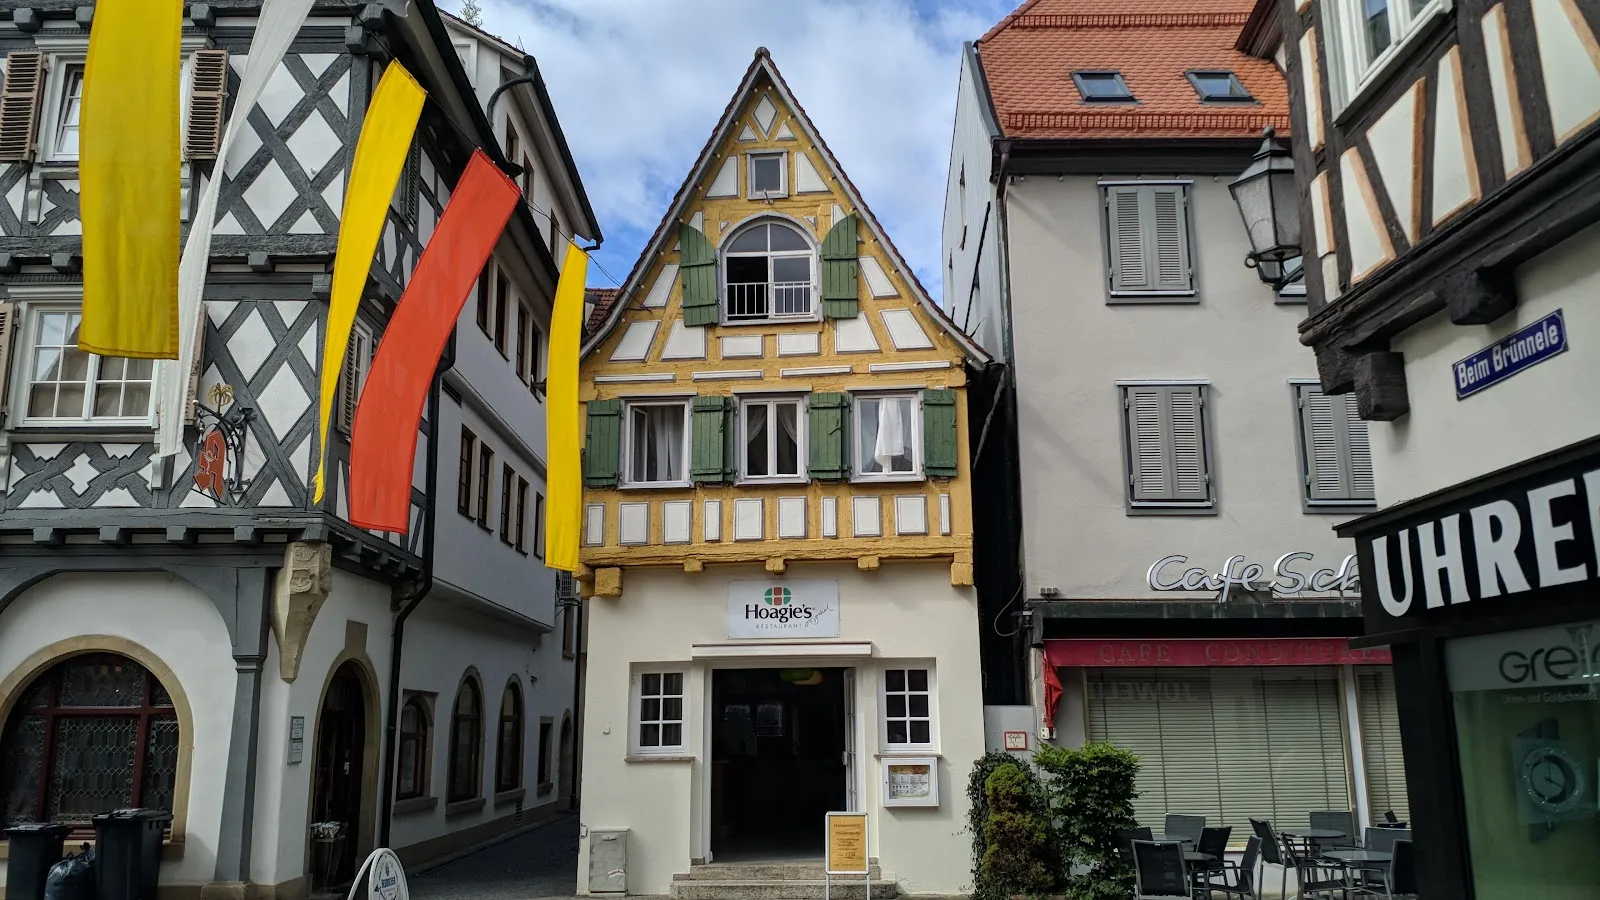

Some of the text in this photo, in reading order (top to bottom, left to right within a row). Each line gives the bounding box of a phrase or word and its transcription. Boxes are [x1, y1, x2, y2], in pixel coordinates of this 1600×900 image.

[1457, 320, 1560, 389] Beim Brünnele
[1146, 554, 1264, 603] Cafe
[745, 604, 812, 623] Hoagie's
[1100, 644, 1171, 662] CAFE
